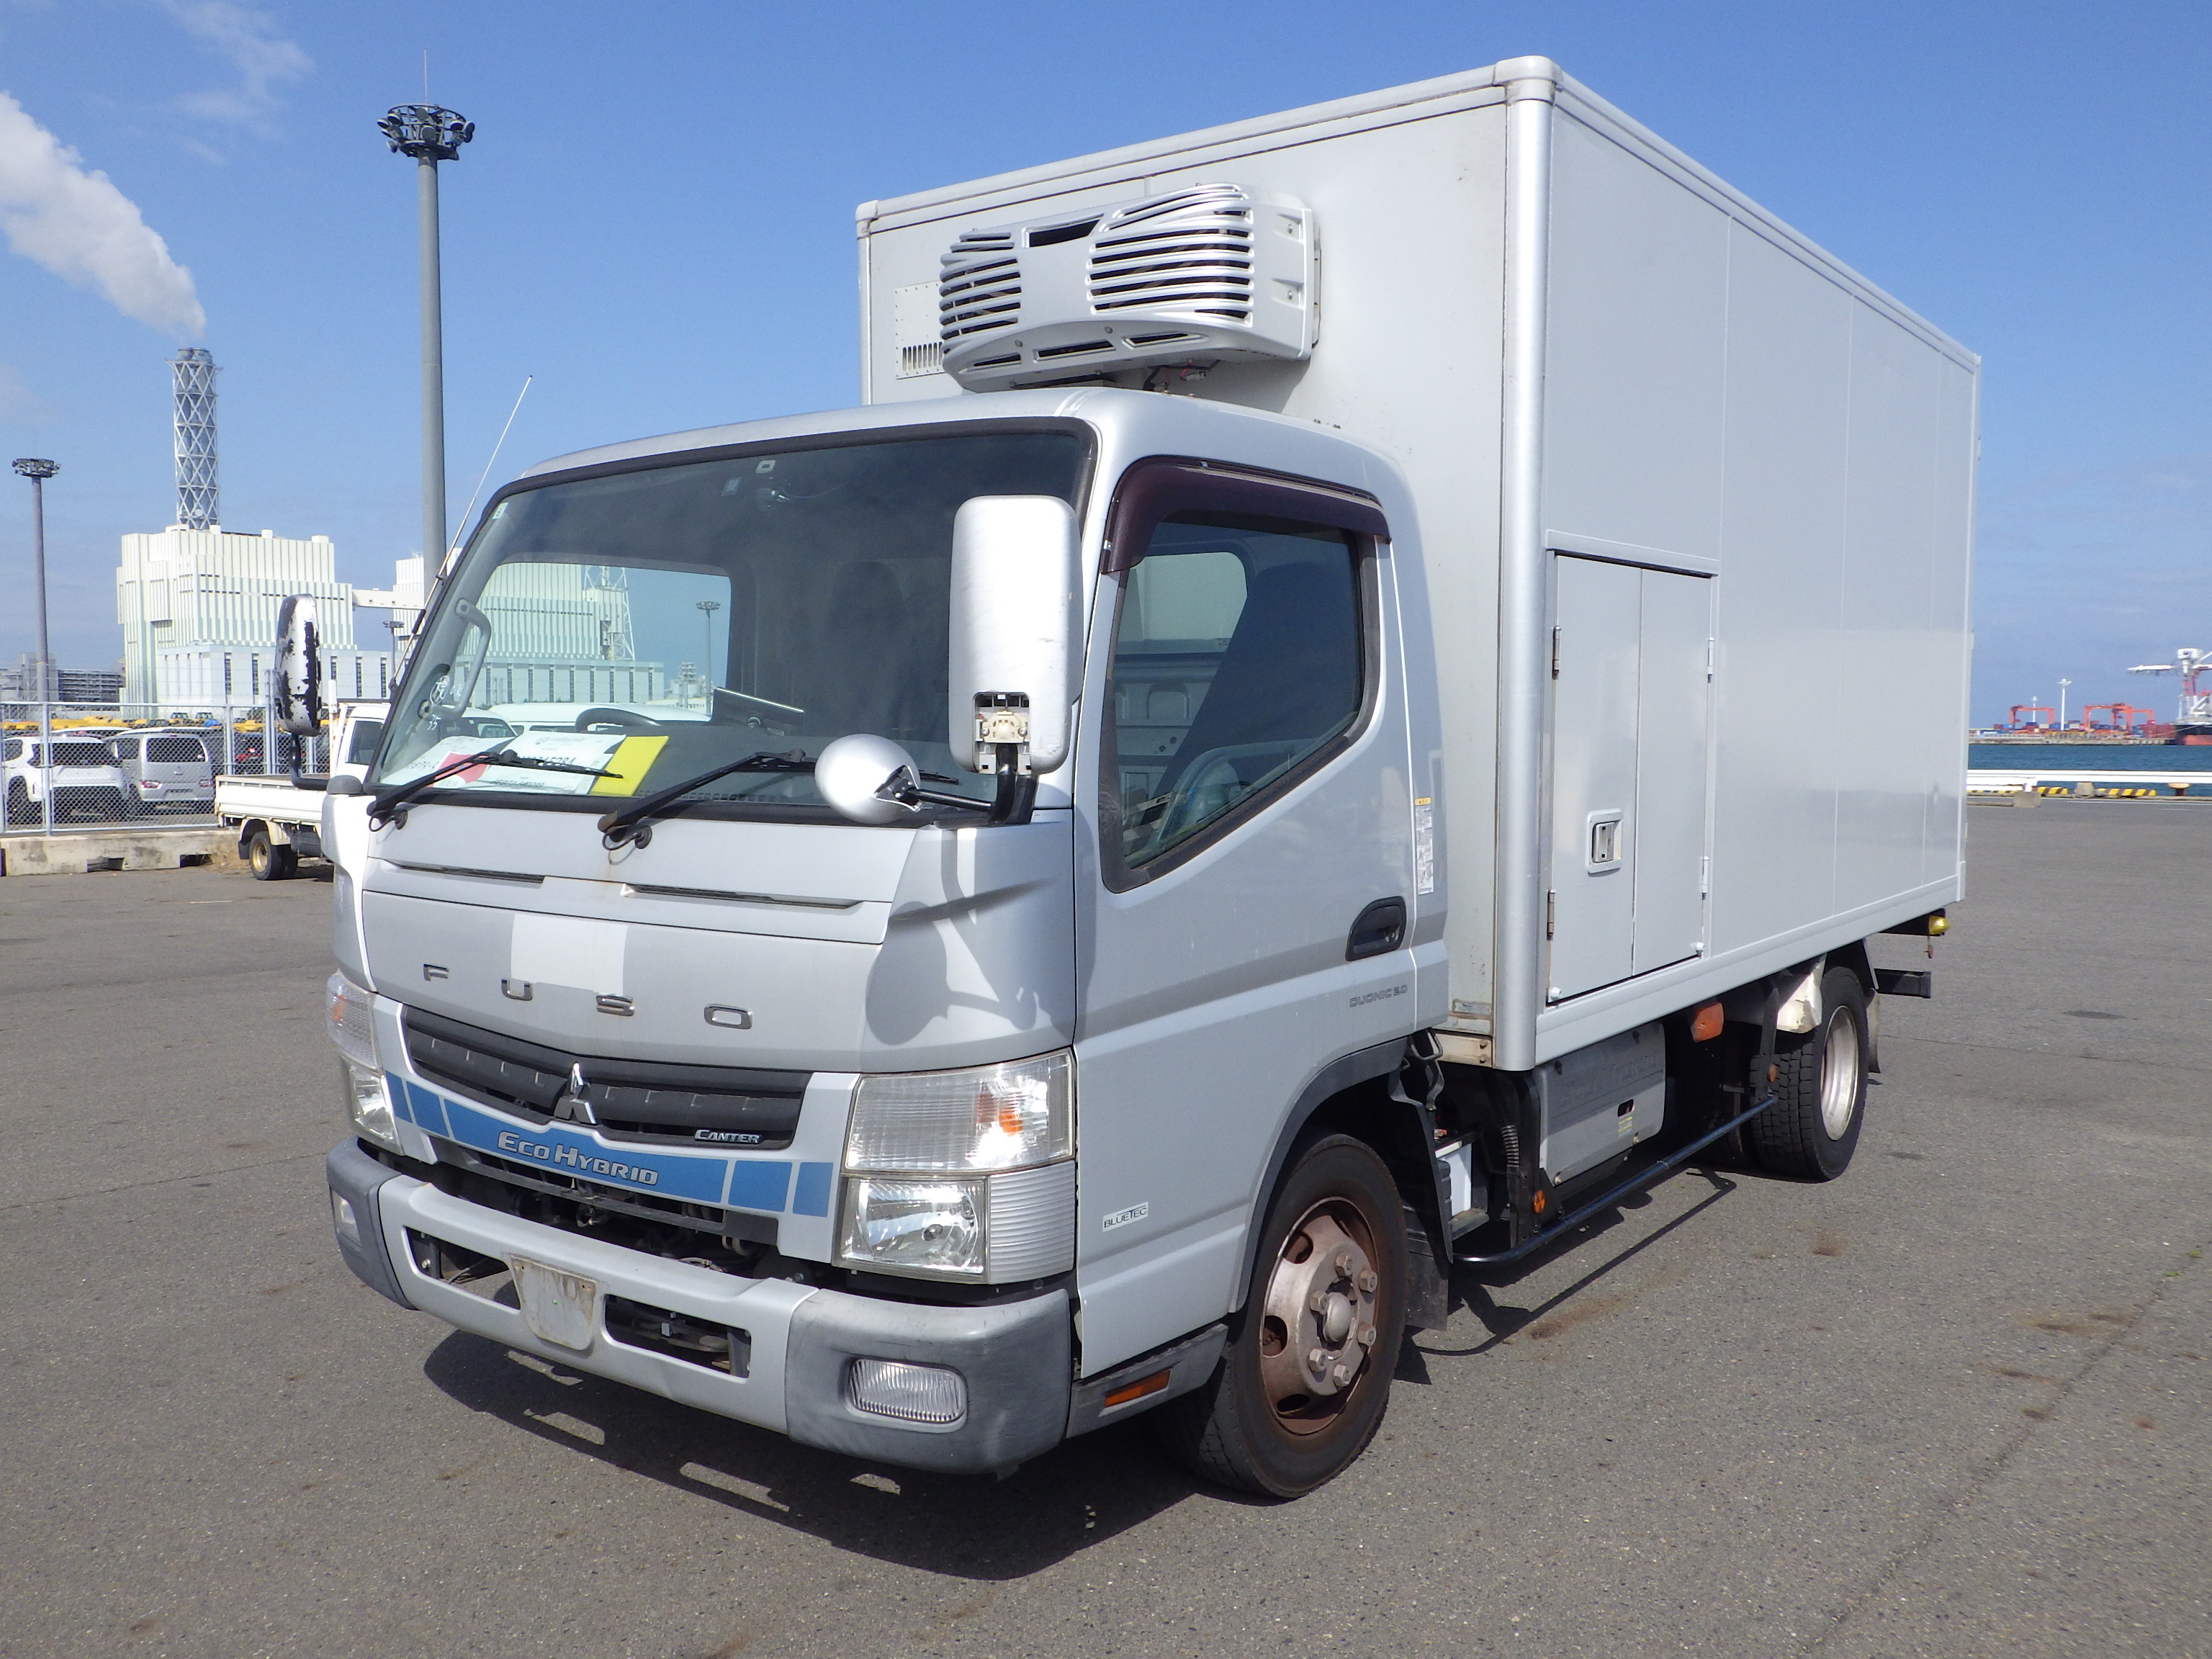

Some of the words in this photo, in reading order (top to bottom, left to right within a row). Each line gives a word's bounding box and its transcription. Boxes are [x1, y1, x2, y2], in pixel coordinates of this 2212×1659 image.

[423, 963, 753, 1030] FUSO
[694, 1128, 760, 1143] CANTER
[1104, 1205, 1147, 1228] BLUETEC
